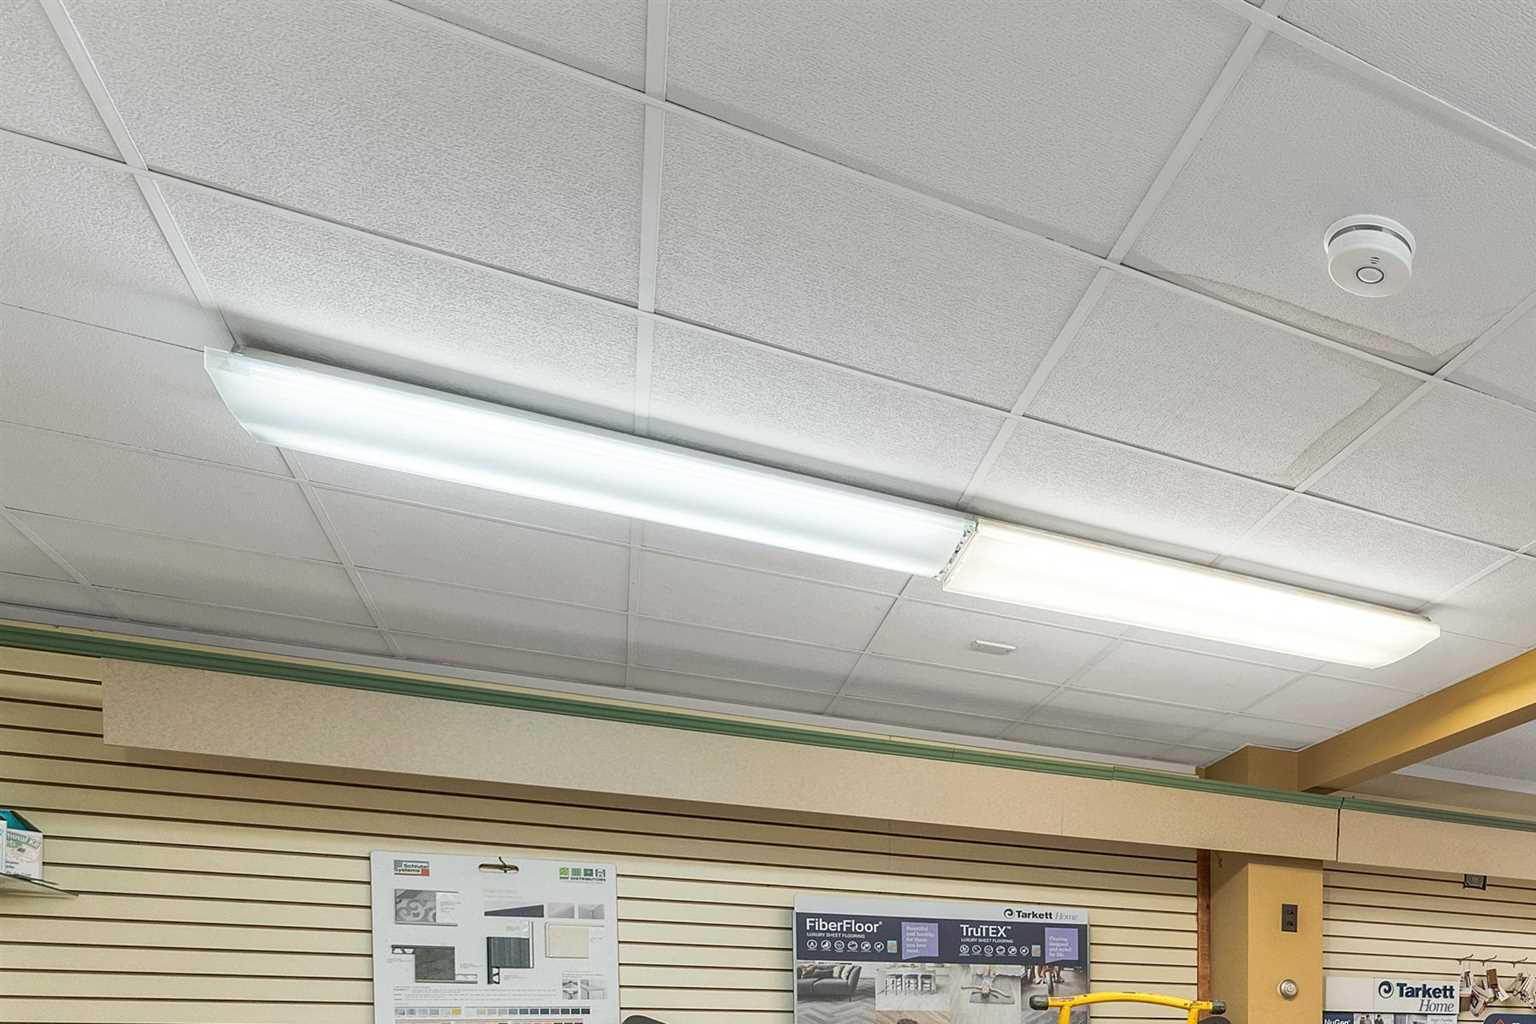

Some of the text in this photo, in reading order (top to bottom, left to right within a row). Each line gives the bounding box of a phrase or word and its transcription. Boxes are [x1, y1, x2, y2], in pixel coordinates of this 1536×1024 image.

[1016, 909, 1053, 920] Tarkett
[805, 917, 880, 933] FiberFloor
[960, 924, 1007, 938] TruTEX
[1396, 982, 1456, 1000] Tarkett
[1419, 999, 1455, 1013] Home
